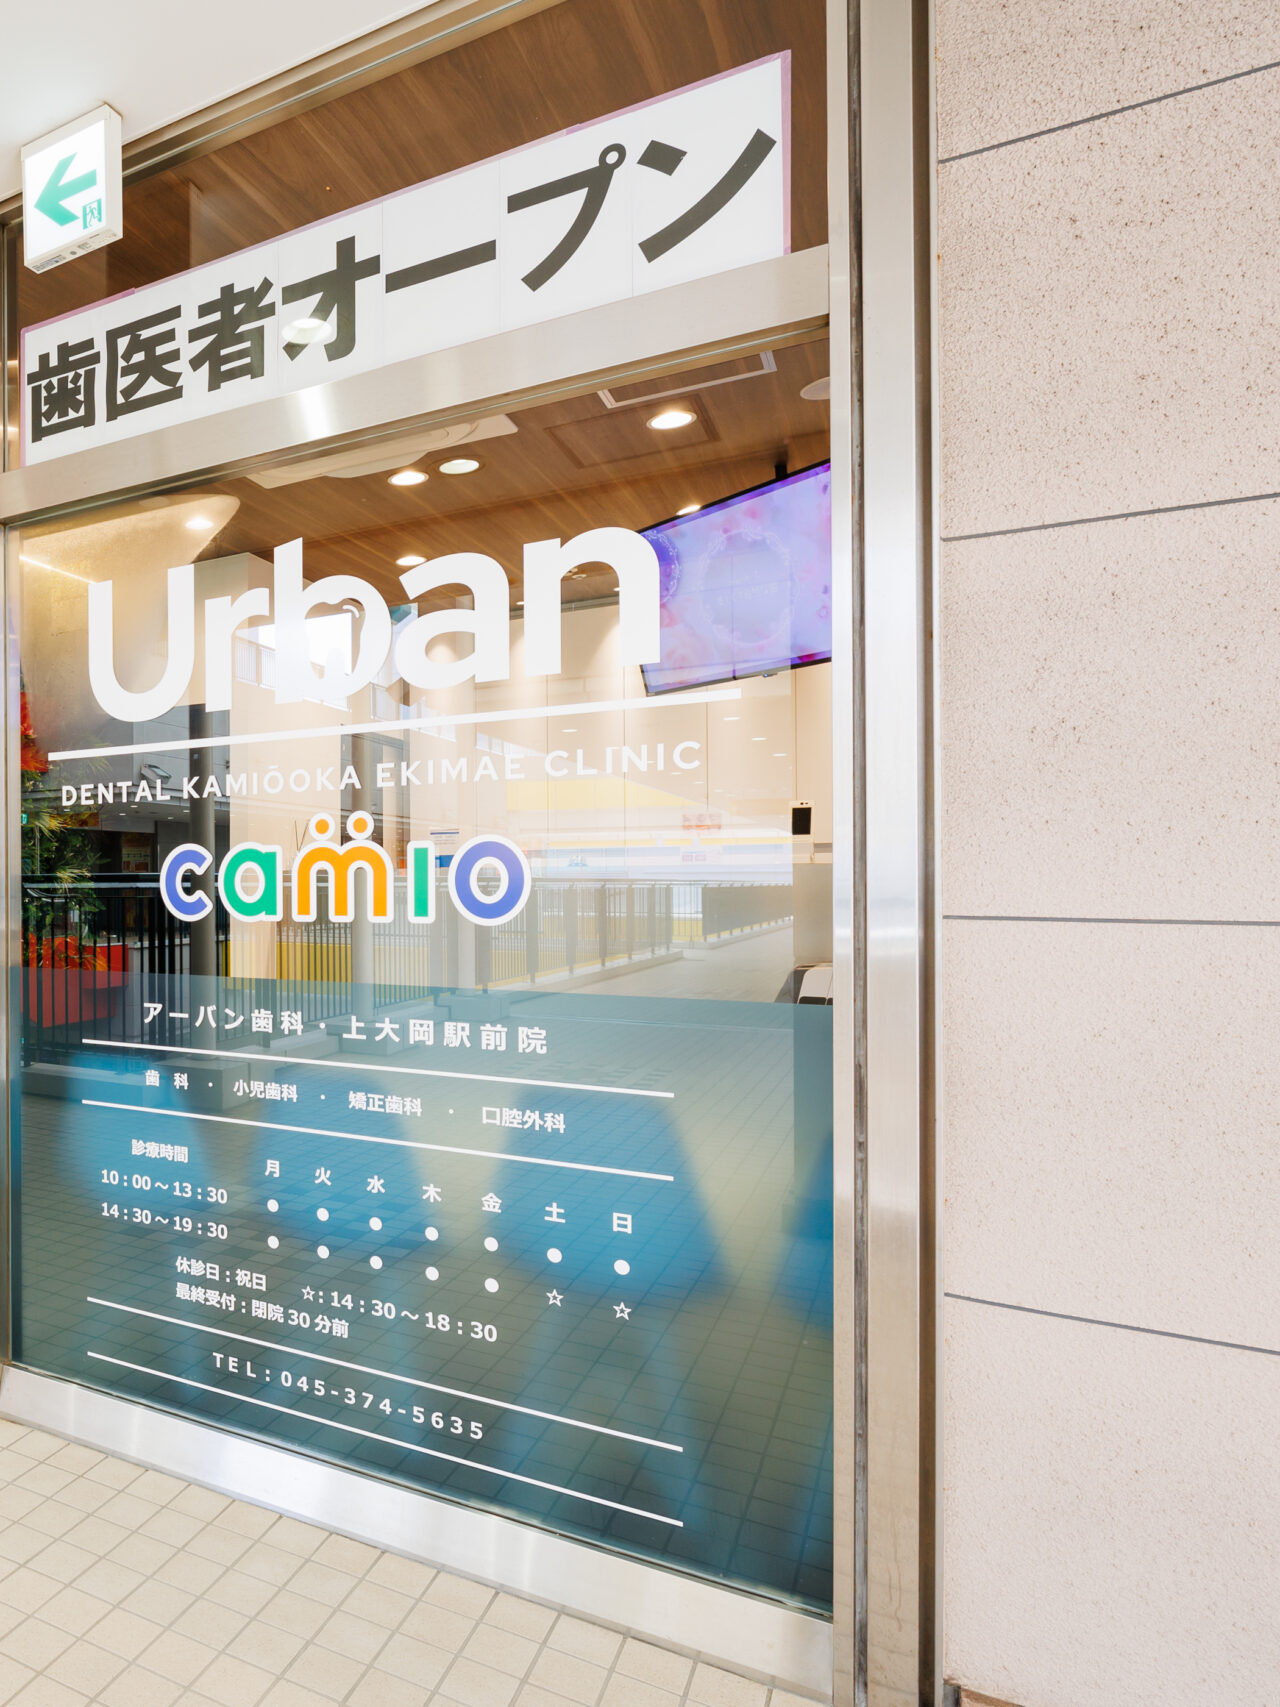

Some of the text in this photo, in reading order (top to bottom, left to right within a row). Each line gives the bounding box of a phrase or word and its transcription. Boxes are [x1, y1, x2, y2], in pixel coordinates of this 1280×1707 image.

[25, 127, 777, 443] 歯医者オープン
[87, 526, 661, 723] Urban
[61, 778, 171, 807] DENTAL
[376, 753, 526, 788] EKIMAE
[544, 741, 702, 777] CLINIC
[233, 1079, 298, 1102] 小児歯科
[348, 1090, 422, 1117] 矯正歯科
[482, 1106, 566, 1134] 口腔外科
[131, 1139, 633, 1234] 診療時間 月 火 水 木 金 土 日
